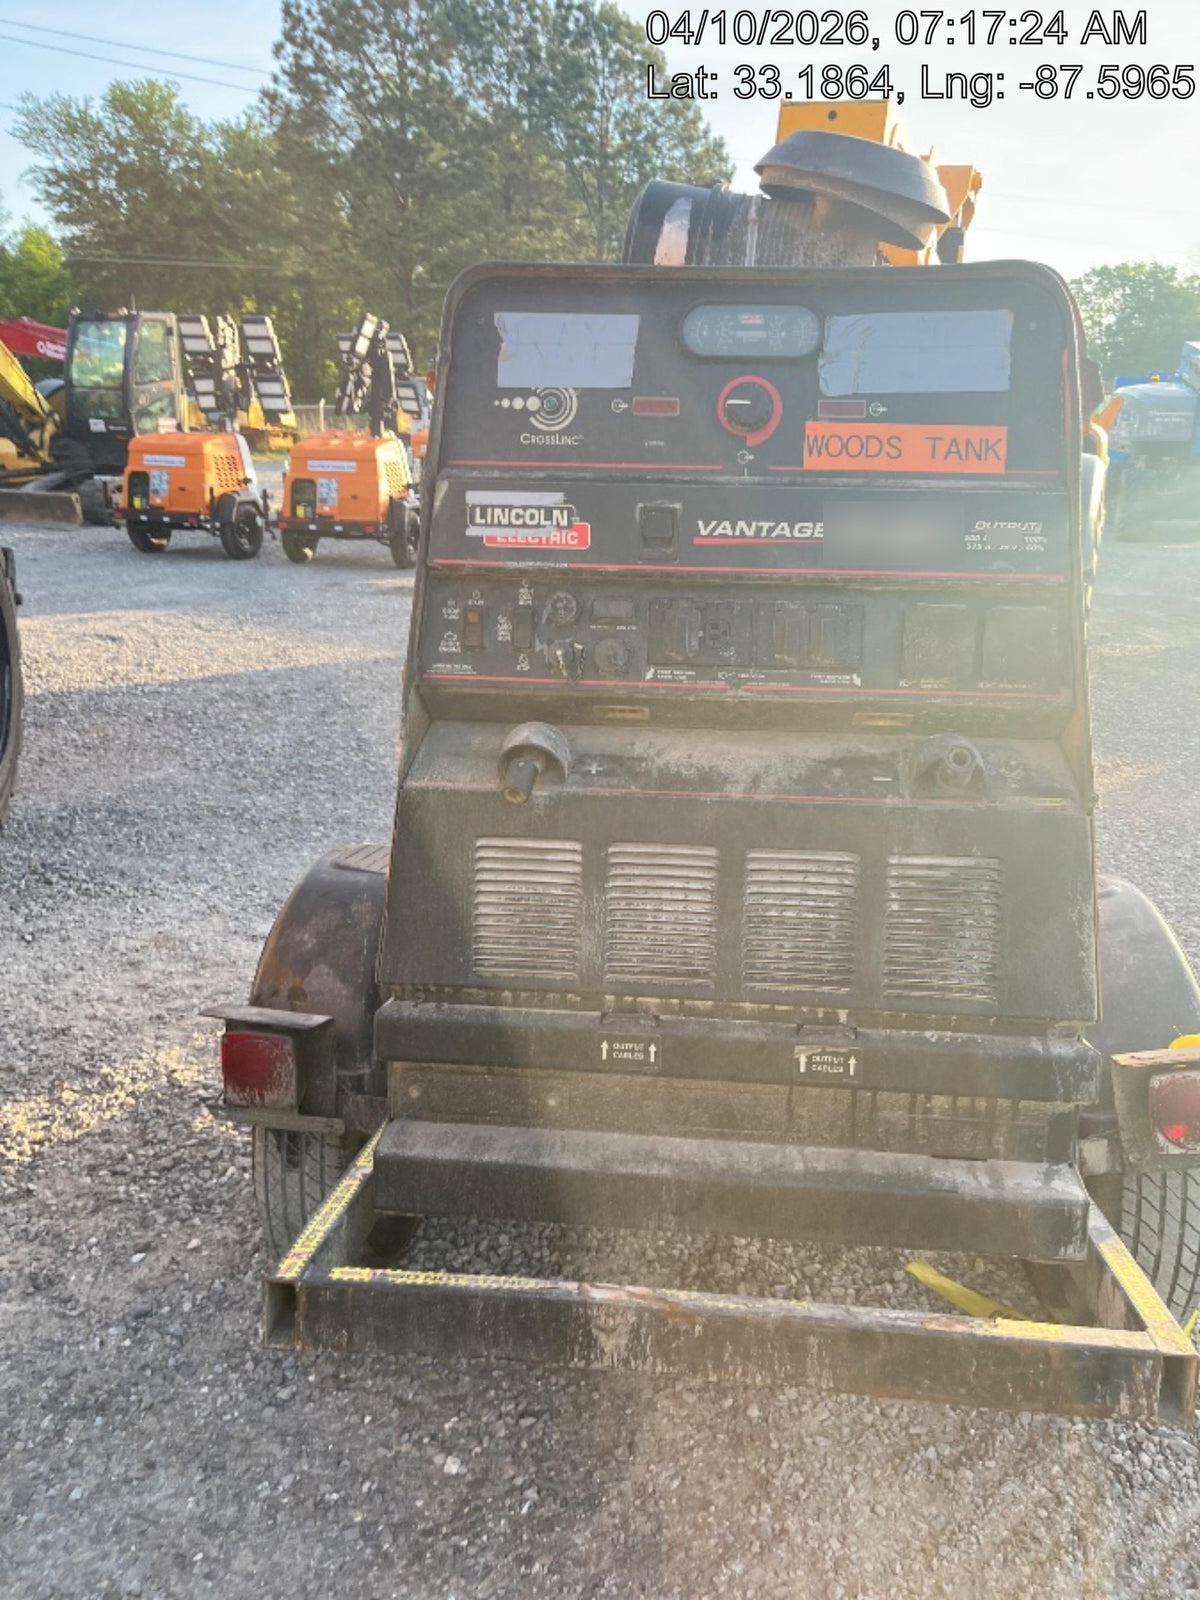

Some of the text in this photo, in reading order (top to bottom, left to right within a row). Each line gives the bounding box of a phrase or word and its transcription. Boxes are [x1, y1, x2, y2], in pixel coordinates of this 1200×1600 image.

[805, 433, 1002, 461] WOODS TANK
[474, 506, 568, 527] LINCOLN
